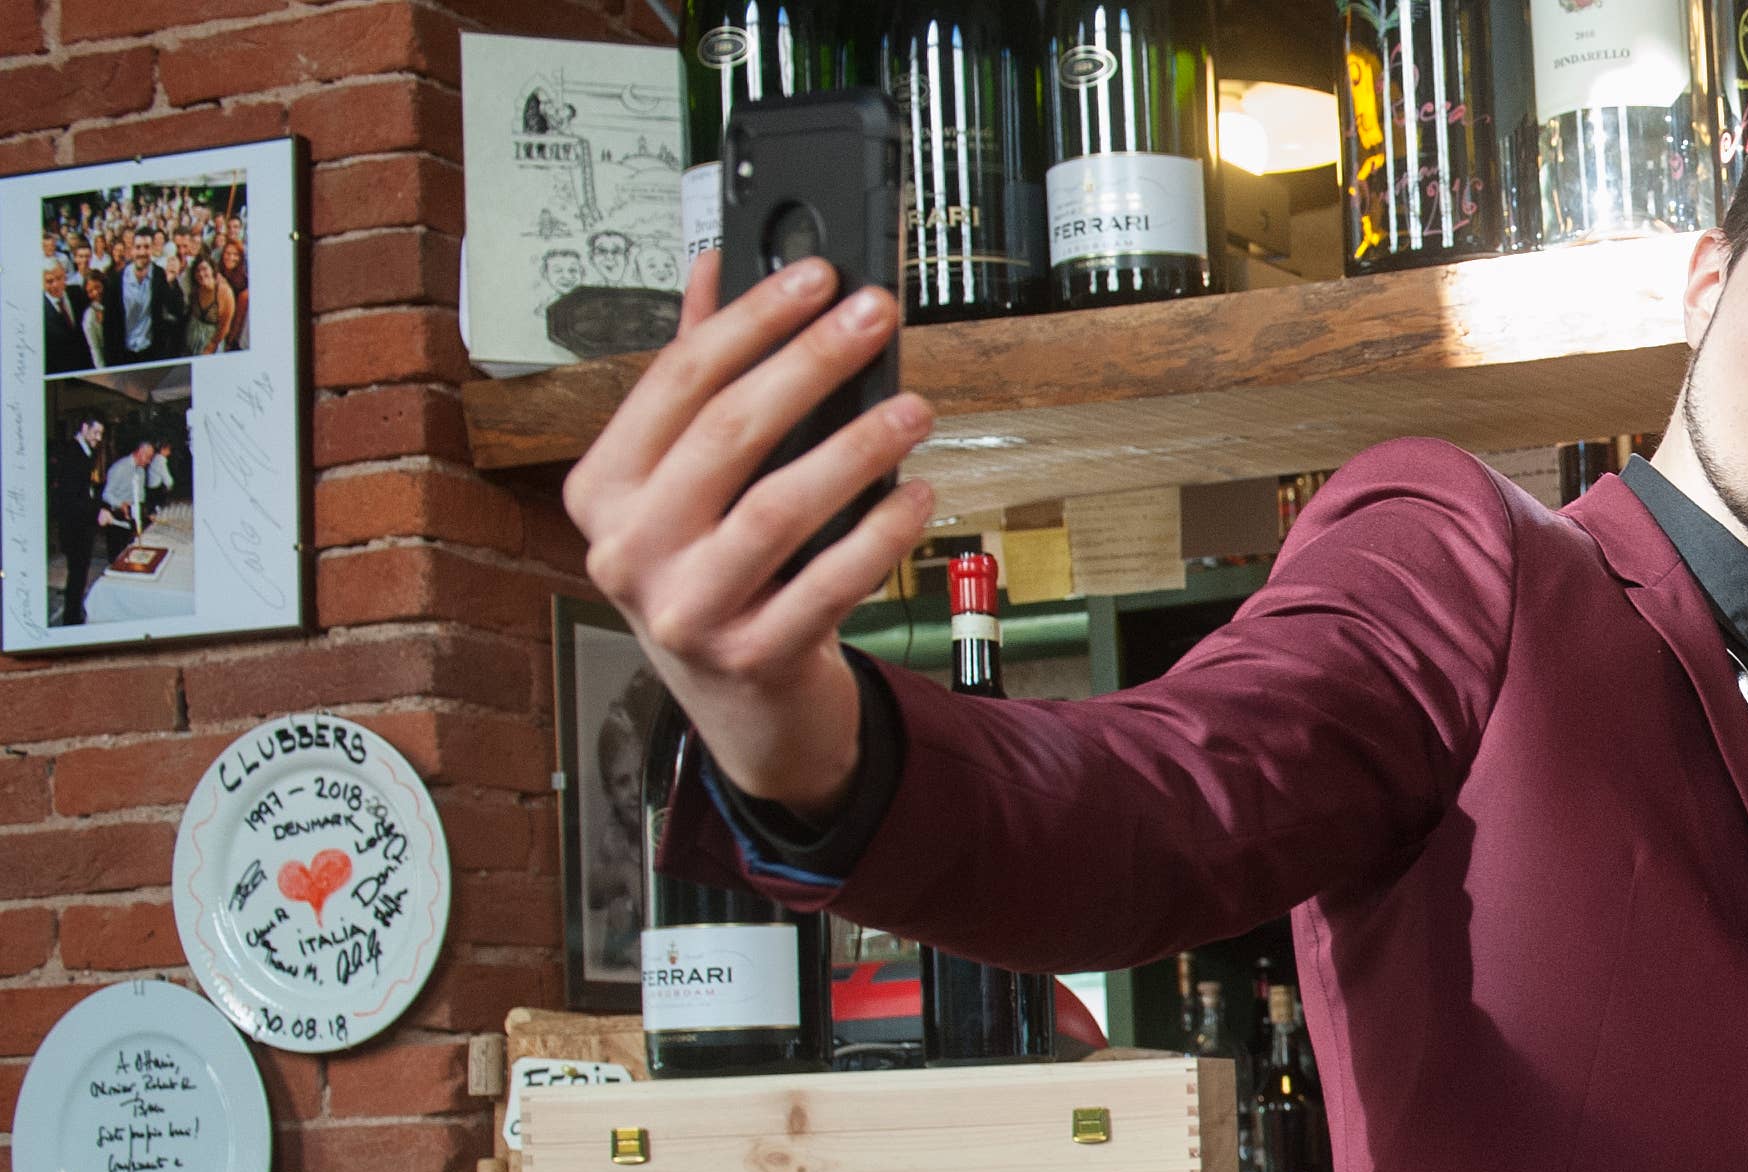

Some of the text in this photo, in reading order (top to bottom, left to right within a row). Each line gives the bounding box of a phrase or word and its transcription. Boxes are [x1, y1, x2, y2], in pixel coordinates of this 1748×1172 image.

[1053, 214, 1150, 243] FERRARI
[218, 722, 367, 792] CLUBBERS
[273, 813, 363, 840] DENMARK
[642, 965, 733, 987] FERRARI
